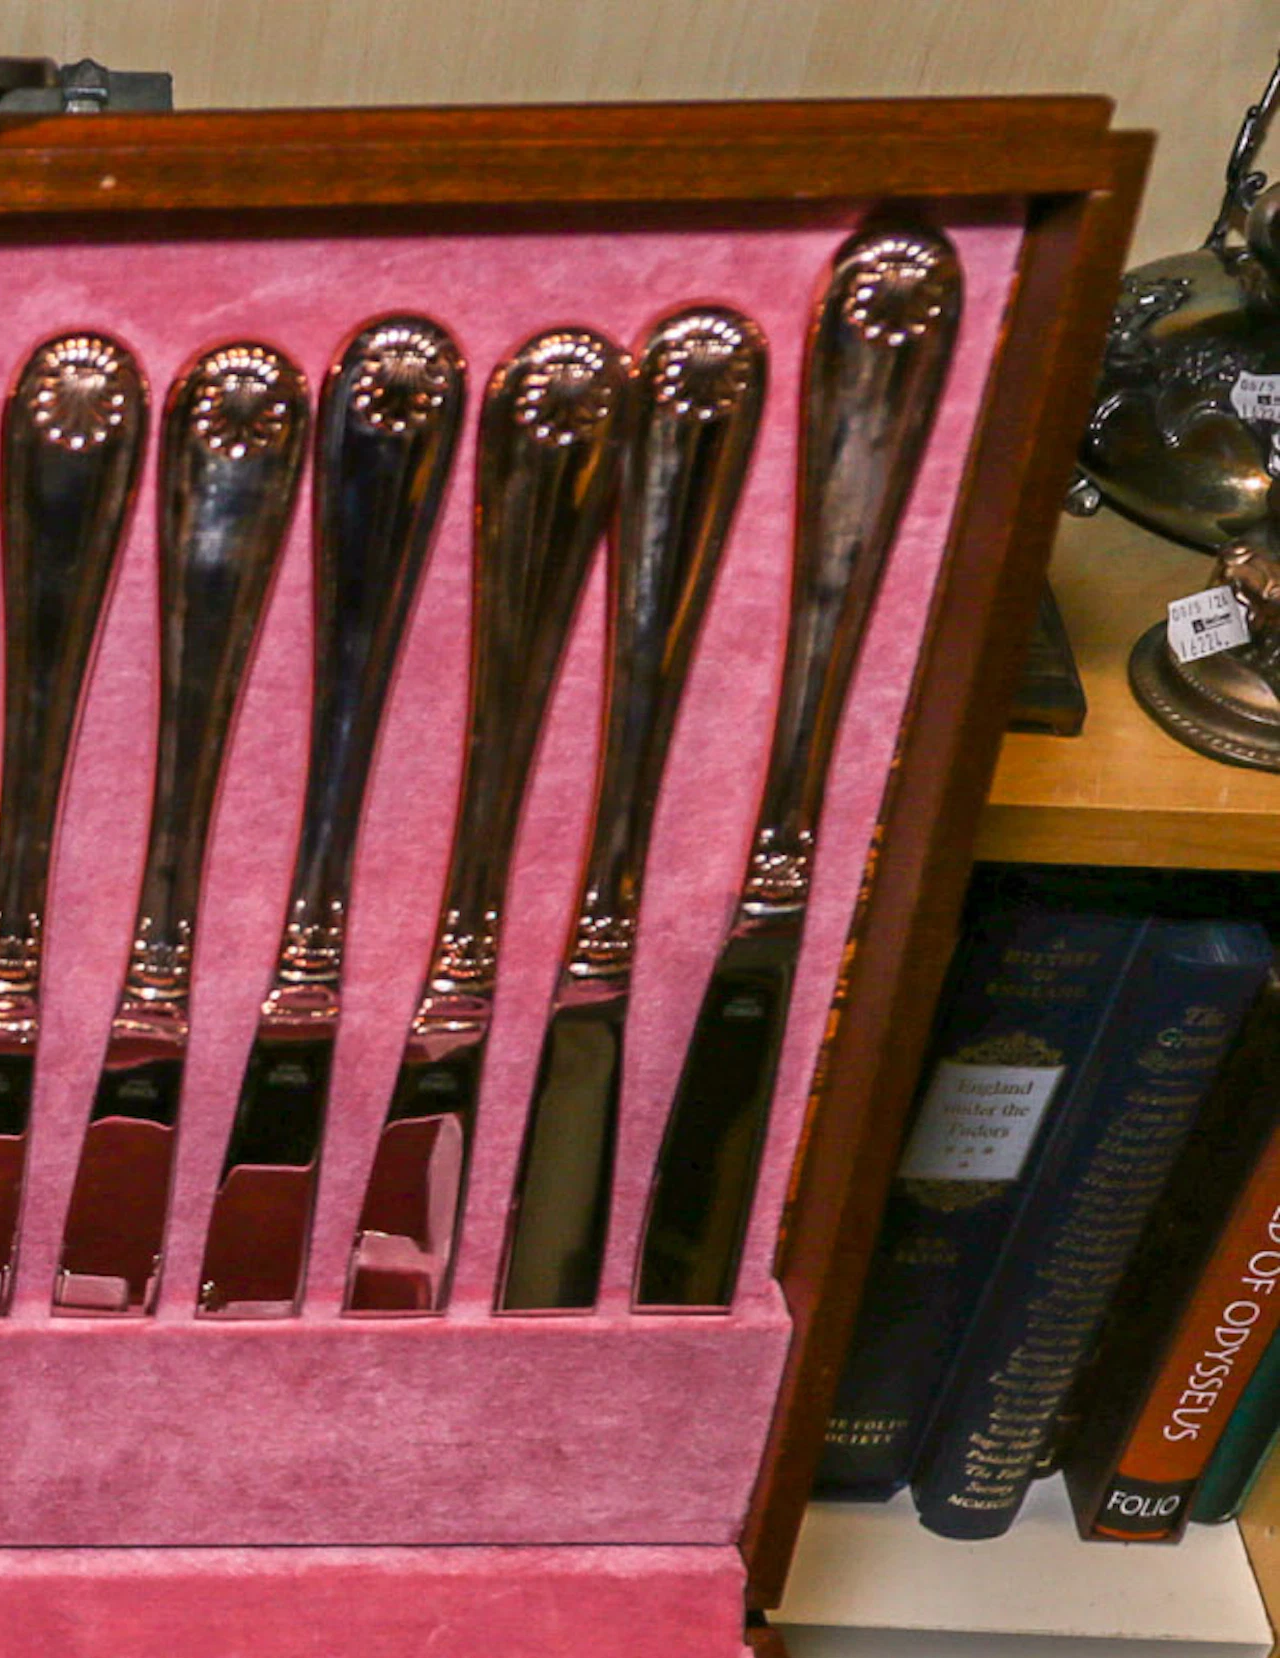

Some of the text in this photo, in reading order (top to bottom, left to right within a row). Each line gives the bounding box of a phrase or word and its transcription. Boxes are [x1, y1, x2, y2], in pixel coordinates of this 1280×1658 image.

[958, 1080, 1035, 1097] England
[1002, 1102, 1030, 1117] the
[1163, 1300, 1261, 1442] ODYSSEUS
[824, 1432, 896, 1446] OCIETY
[1106, 1490, 1181, 1518] FOLIO
